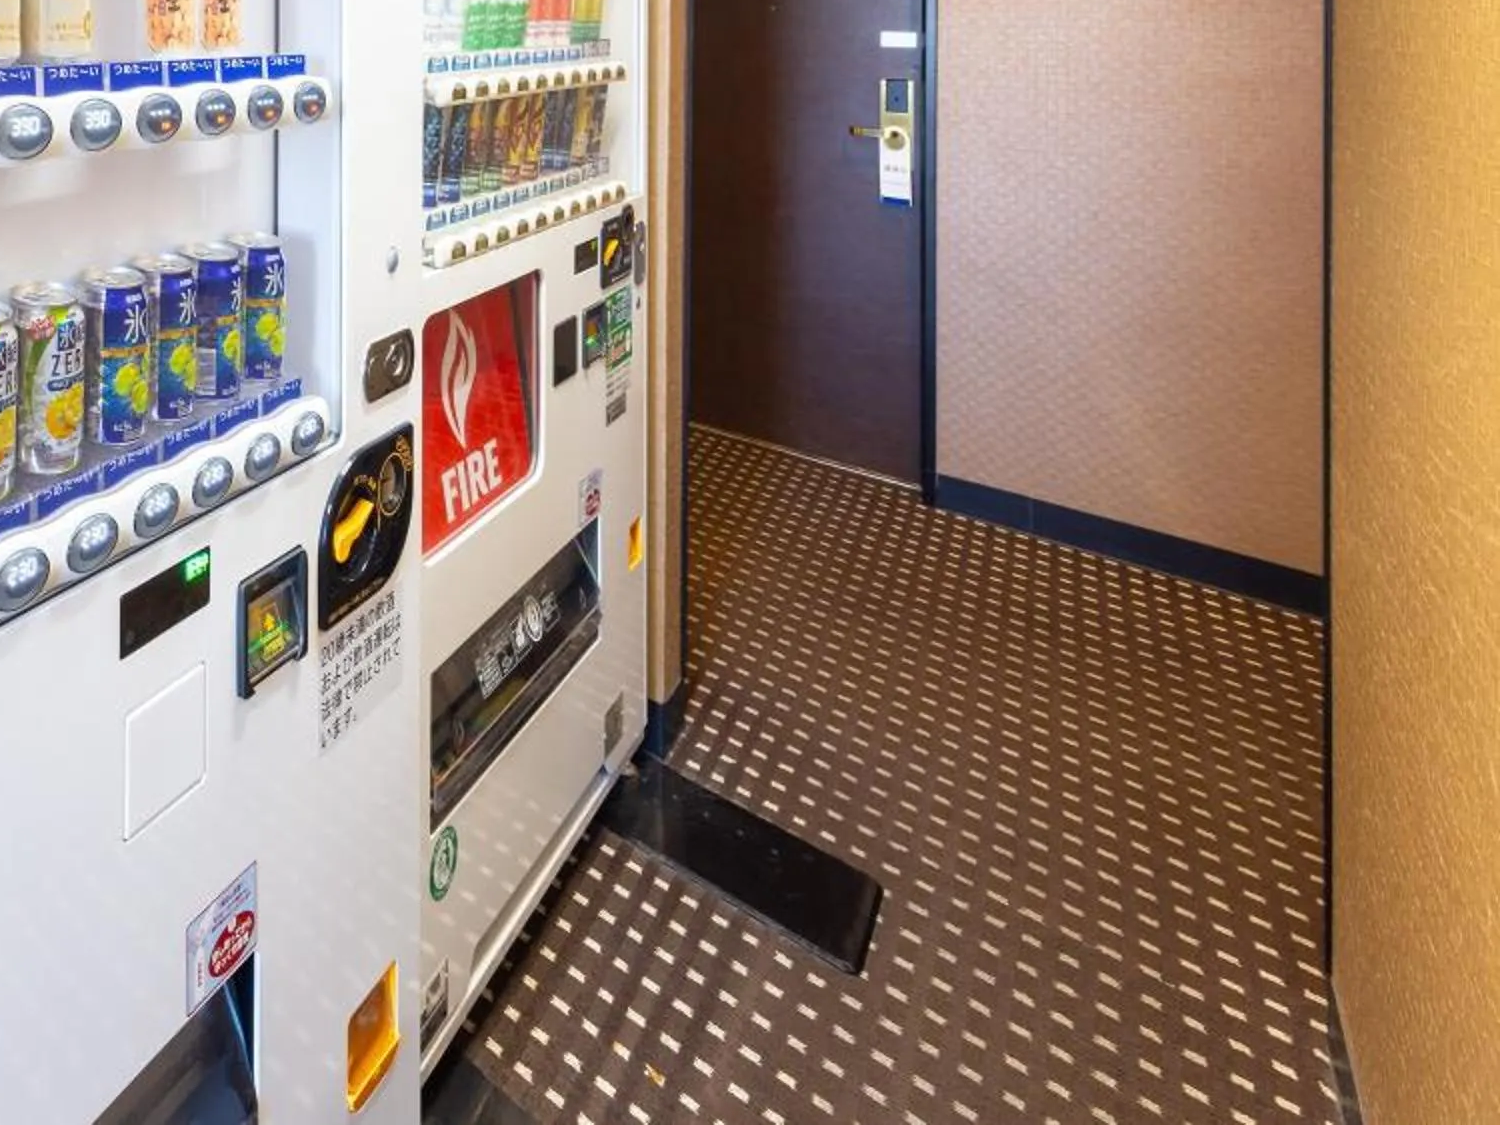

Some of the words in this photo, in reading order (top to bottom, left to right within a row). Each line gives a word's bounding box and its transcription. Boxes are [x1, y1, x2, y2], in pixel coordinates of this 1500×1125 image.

[10, 116, 41, 137] 390
[440, 437, 503, 524] FIRE
[7, 556, 38, 586] 230
